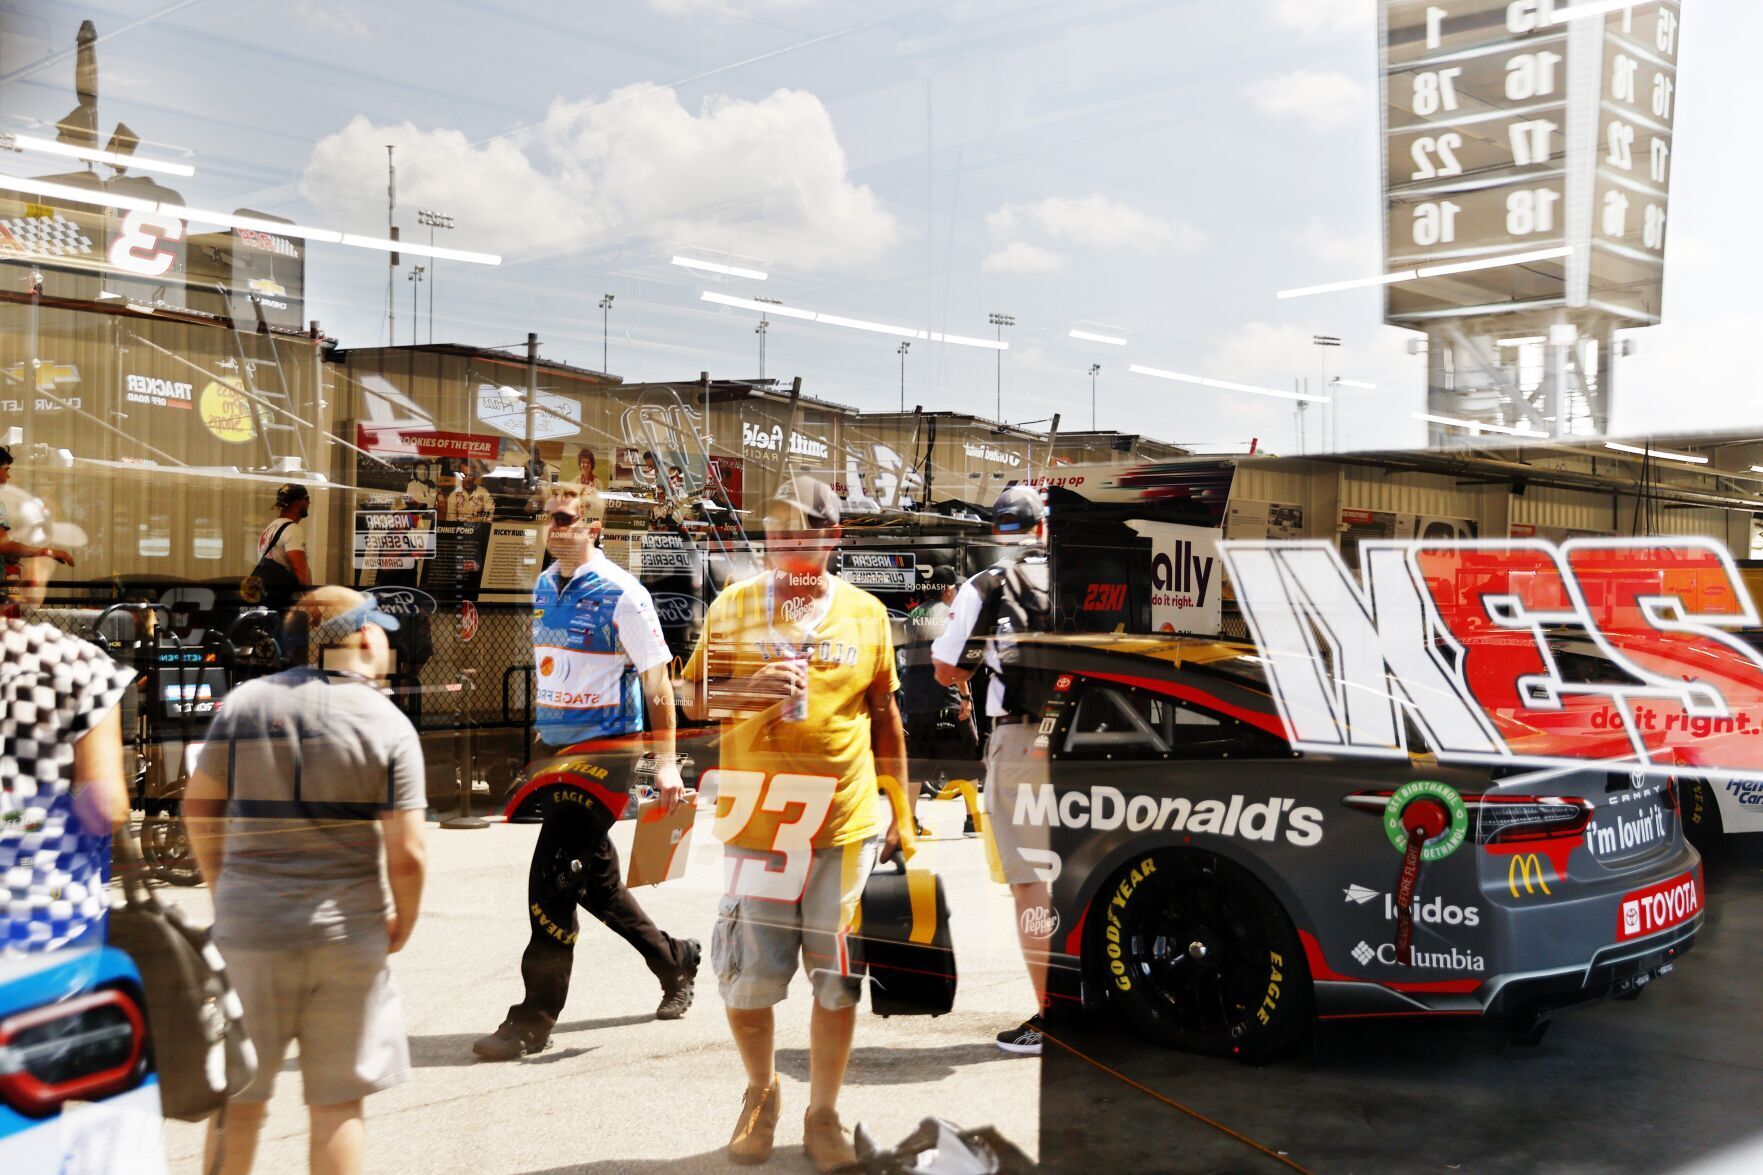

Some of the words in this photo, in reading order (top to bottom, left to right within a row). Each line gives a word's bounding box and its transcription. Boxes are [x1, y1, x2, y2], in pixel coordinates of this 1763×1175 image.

[437, 439, 450, 448] OF
[451, 440, 468, 450] THE
[468, 441, 492, 452] YEAR
[437, 526, 456, 534] ENNIE
[788, 572, 823, 586] leidos
[1152, 539, 1214, 607] ally
[1083, 584, 1127, 612] 23XI
[1152, 594, 1162, 606] do
[1163, 594, 1171, 606] it
[1172, 594, 1194, 610] right.
[553, 790, 594, 809] EAGLE
[1388, 797, 1403, 812] GET
[1403, 782, 1458, 806] BIOETHANOL
[1608, 785, 1660, 805] CAMRY
[1012, 782, 1324, 847] McDonald's
[1654, 804, 1666, 838] it
[1395, 834, 1407, 850] GE
[1420, 827, 1465, 859] IOETHANOL
[1035, 906, 1050, 920] Dr
[1641, 880, 1697, 930] TOYOTA
[1022, 908, 1057, 935] Pepper
[1106, 857, 1157, 991] GOODYEAR
[1377, 943, 1484, 971] Clumbia
[1256, 950, 1283, 1025] EAGLE
